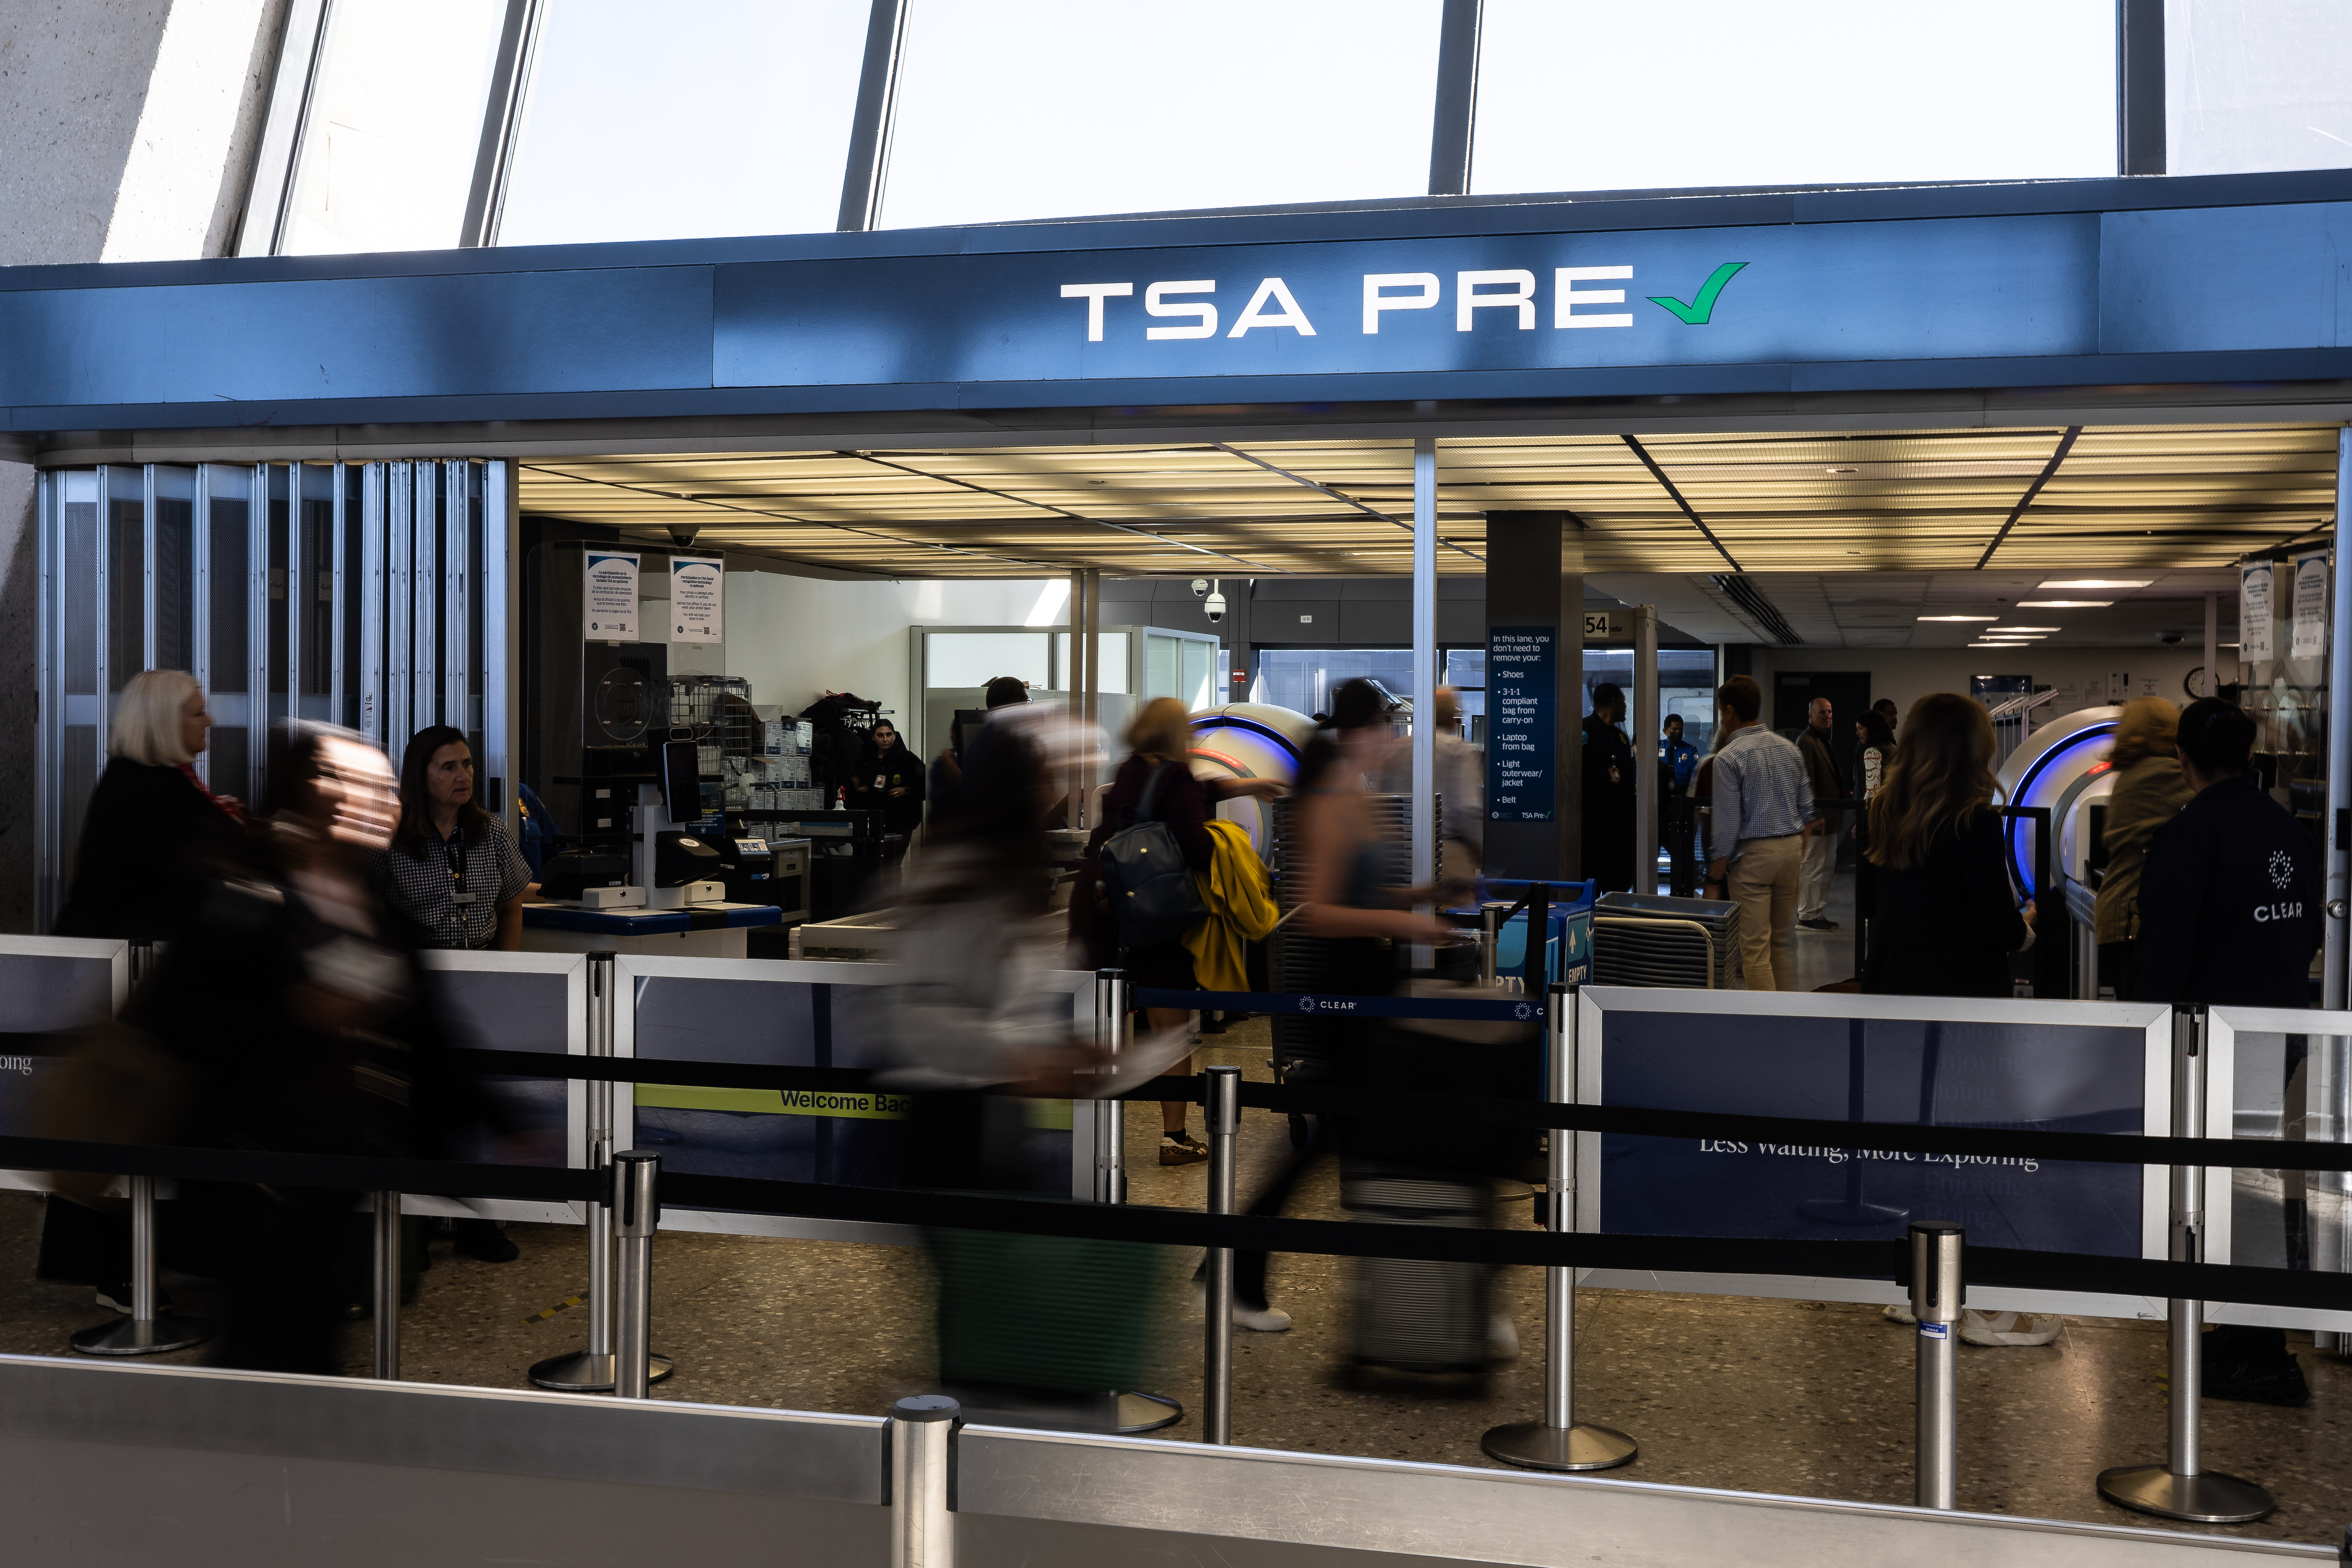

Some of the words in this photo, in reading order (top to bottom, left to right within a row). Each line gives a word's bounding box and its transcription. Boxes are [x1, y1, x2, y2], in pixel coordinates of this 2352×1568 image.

[1059, 277, 1317, 342] TSA
[1362, 265, 1634, 334] PRE
[1586, 617, 1607, 633] 54
[1502, 707, 1516, 715] bag
[1521, 743, 1535, 751] bag
[2254, 902, 2302, 922] CLEAR
[1568, 965, 1587, 982] EMPTY
[1496, 976, 1525, 994] PTY
[0, 1056, 32, 1075] oing
[779, 1090, 869, 1111] Welcome
[874, 1094, 911, 1114] Bac
[1700, 1139, 1748, 1154] Less
